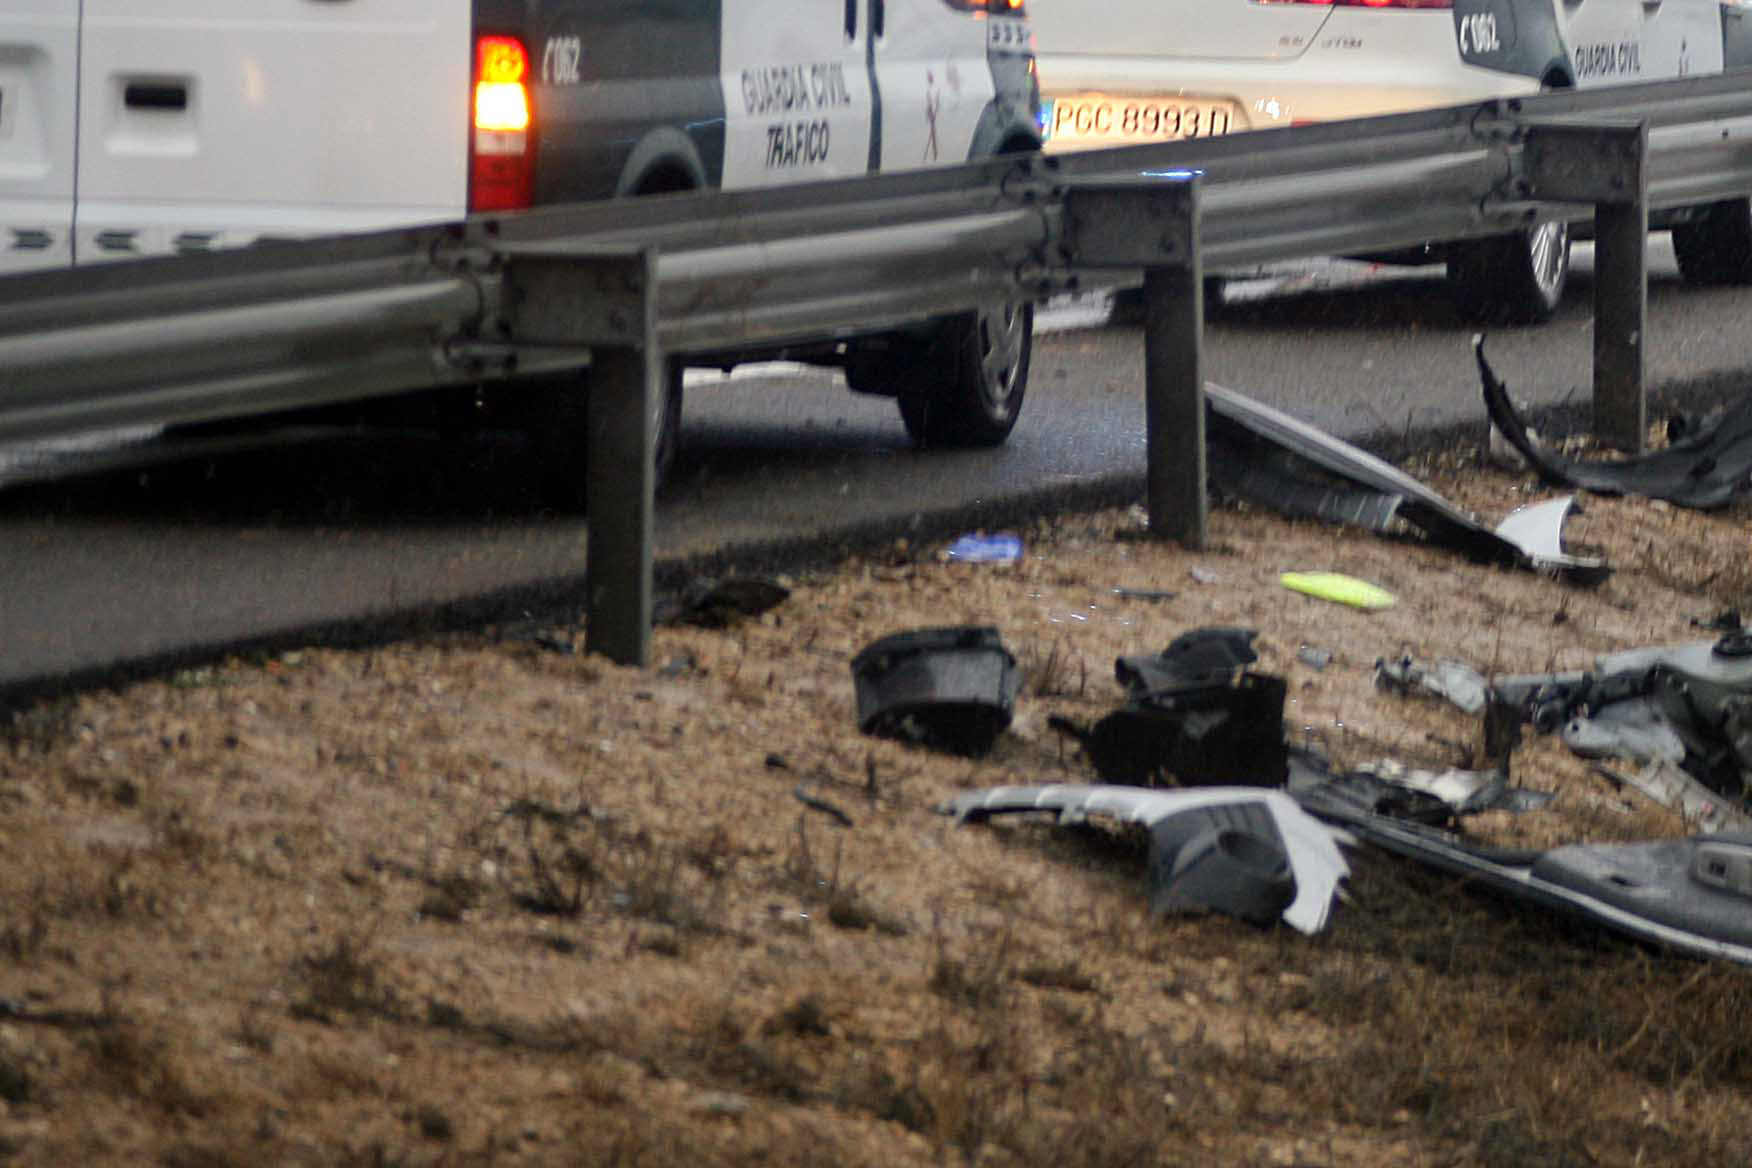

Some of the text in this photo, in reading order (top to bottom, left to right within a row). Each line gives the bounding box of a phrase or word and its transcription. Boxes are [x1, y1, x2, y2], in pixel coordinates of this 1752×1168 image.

[1574, 40, 1641, 78] GUARDIA CIVIL
[741, 60, 851, 115] GUARDIA CIVIL
[1055, 103, 1112, 135] PGC
[1121, 103, 1200, 138] 8993
[765, 120, 830, 168] TRAFICO
